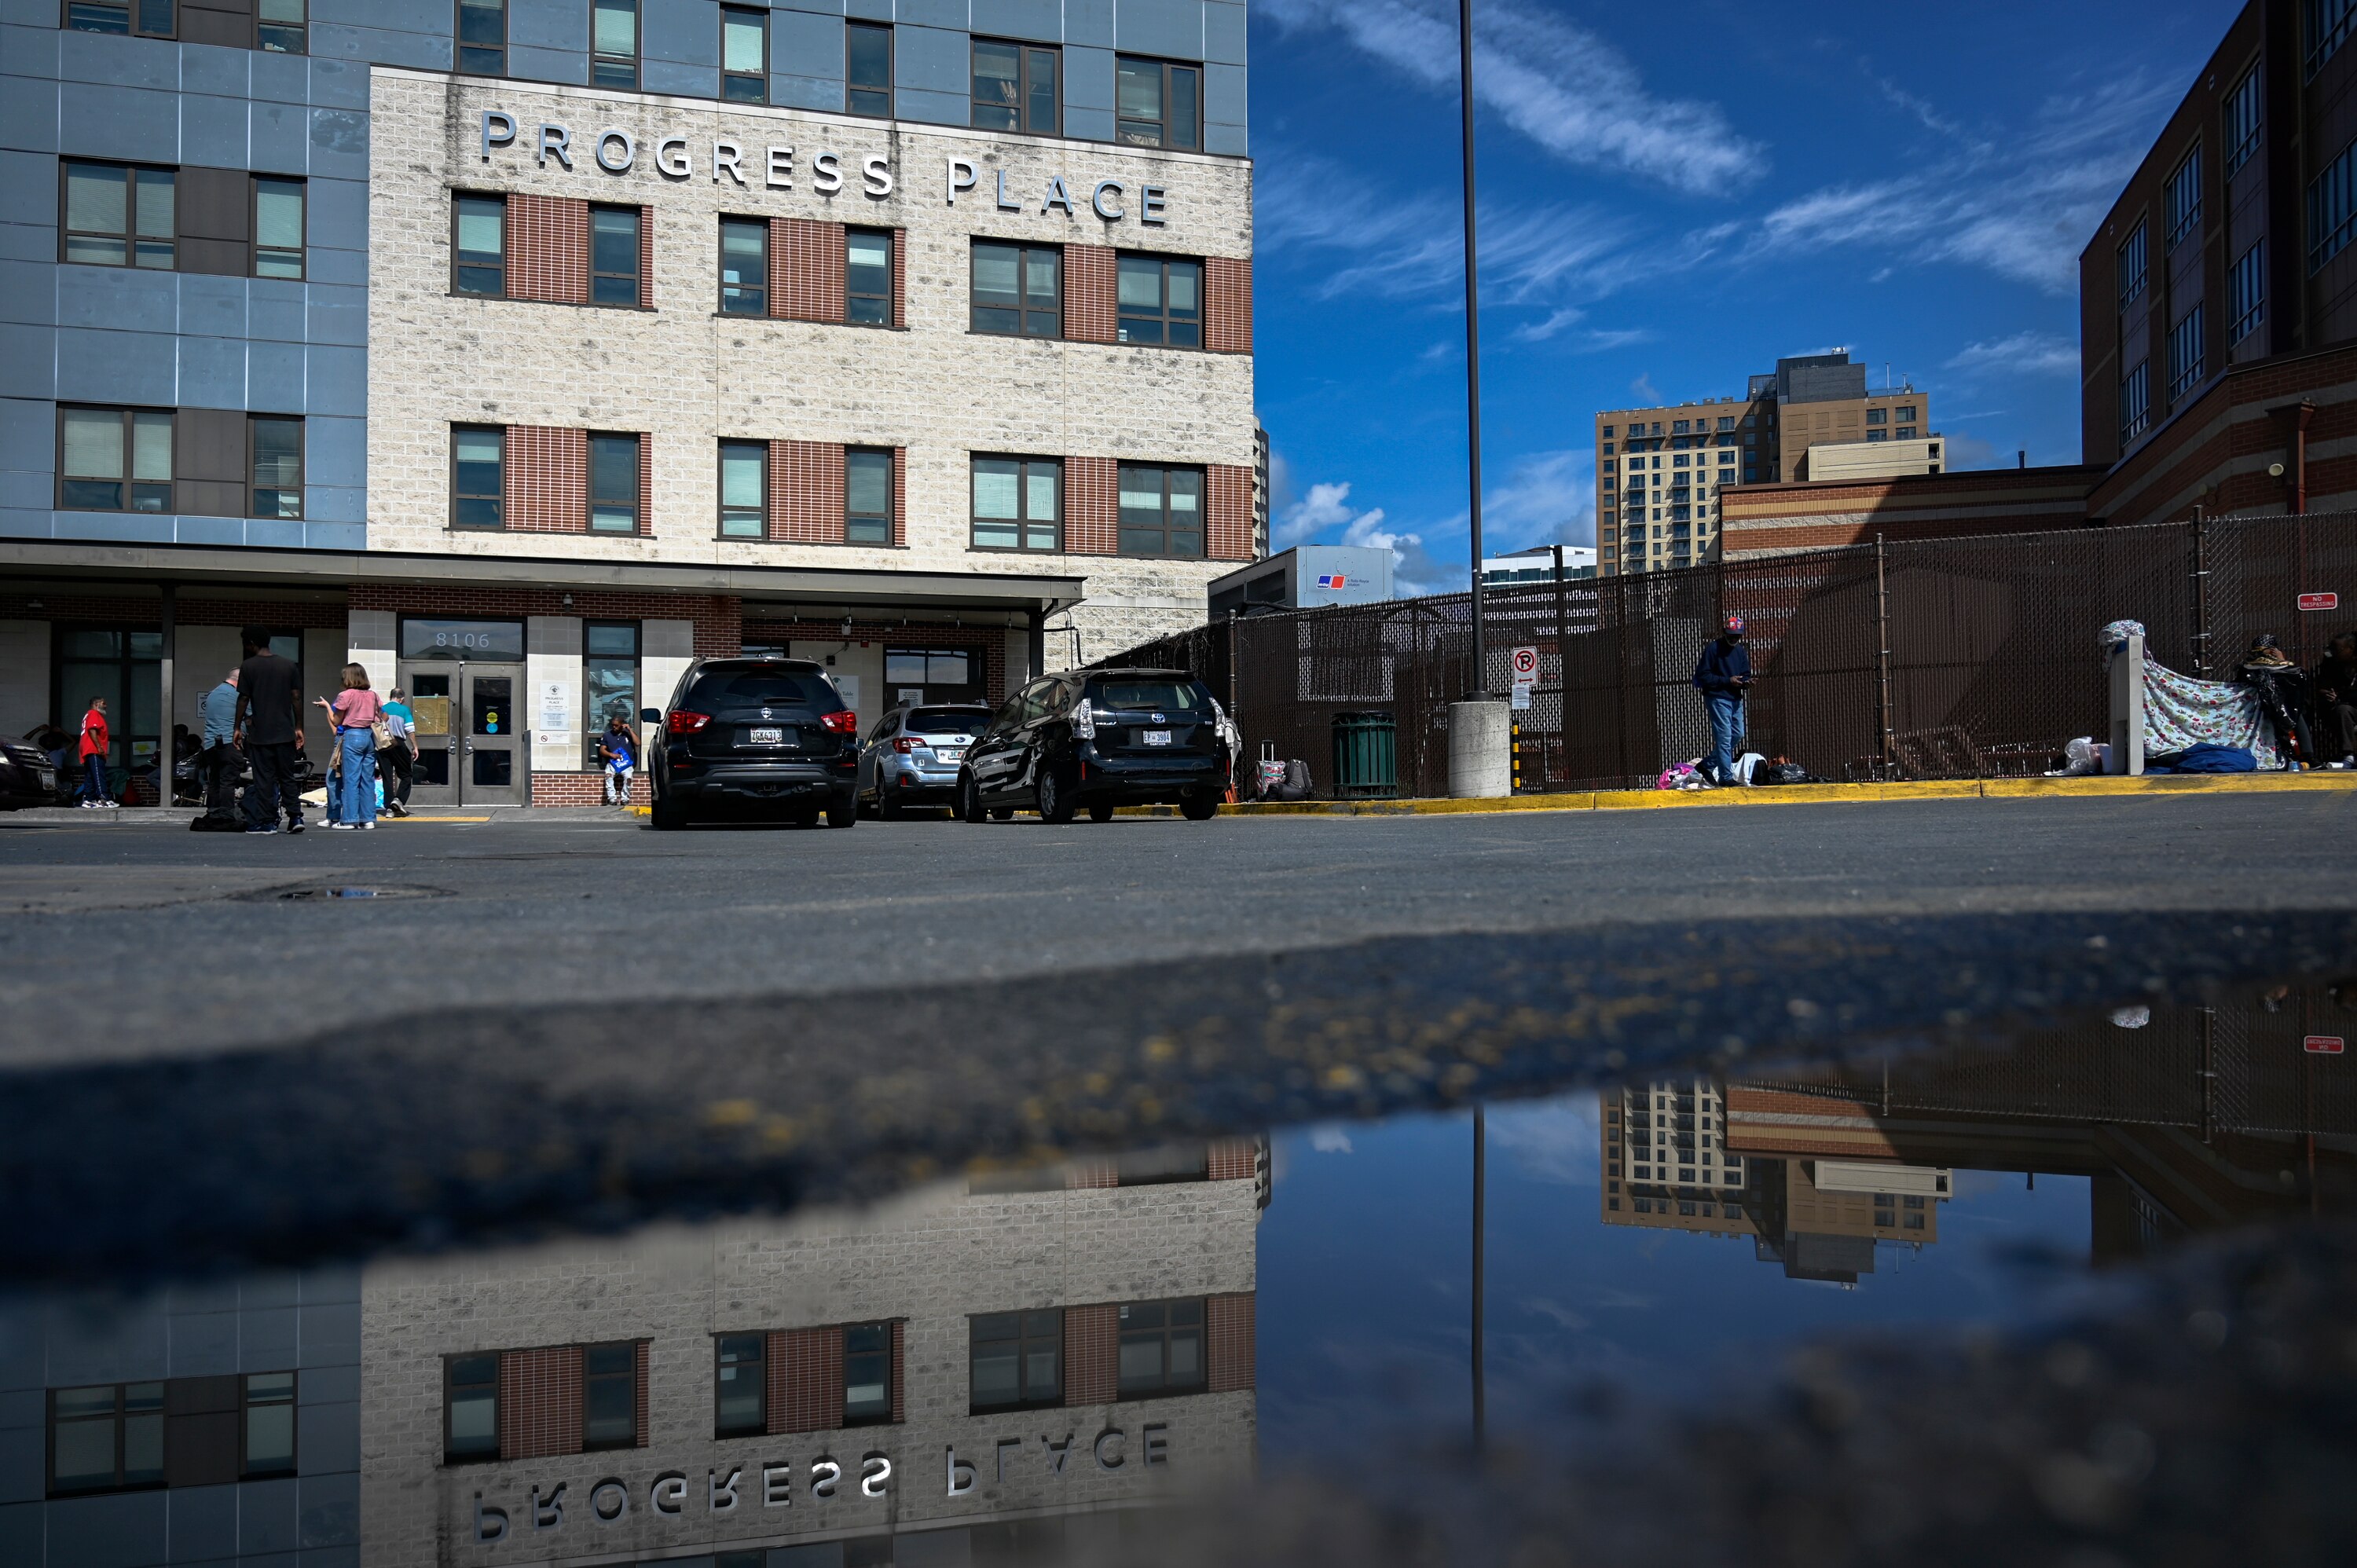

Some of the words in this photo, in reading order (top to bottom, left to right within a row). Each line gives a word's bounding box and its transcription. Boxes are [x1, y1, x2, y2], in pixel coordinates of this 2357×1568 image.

[482, 110, 893, 196] PROGRESS
[948, 156, 1167, 223] PLACE
[436, 632, 489, 648] 8106
